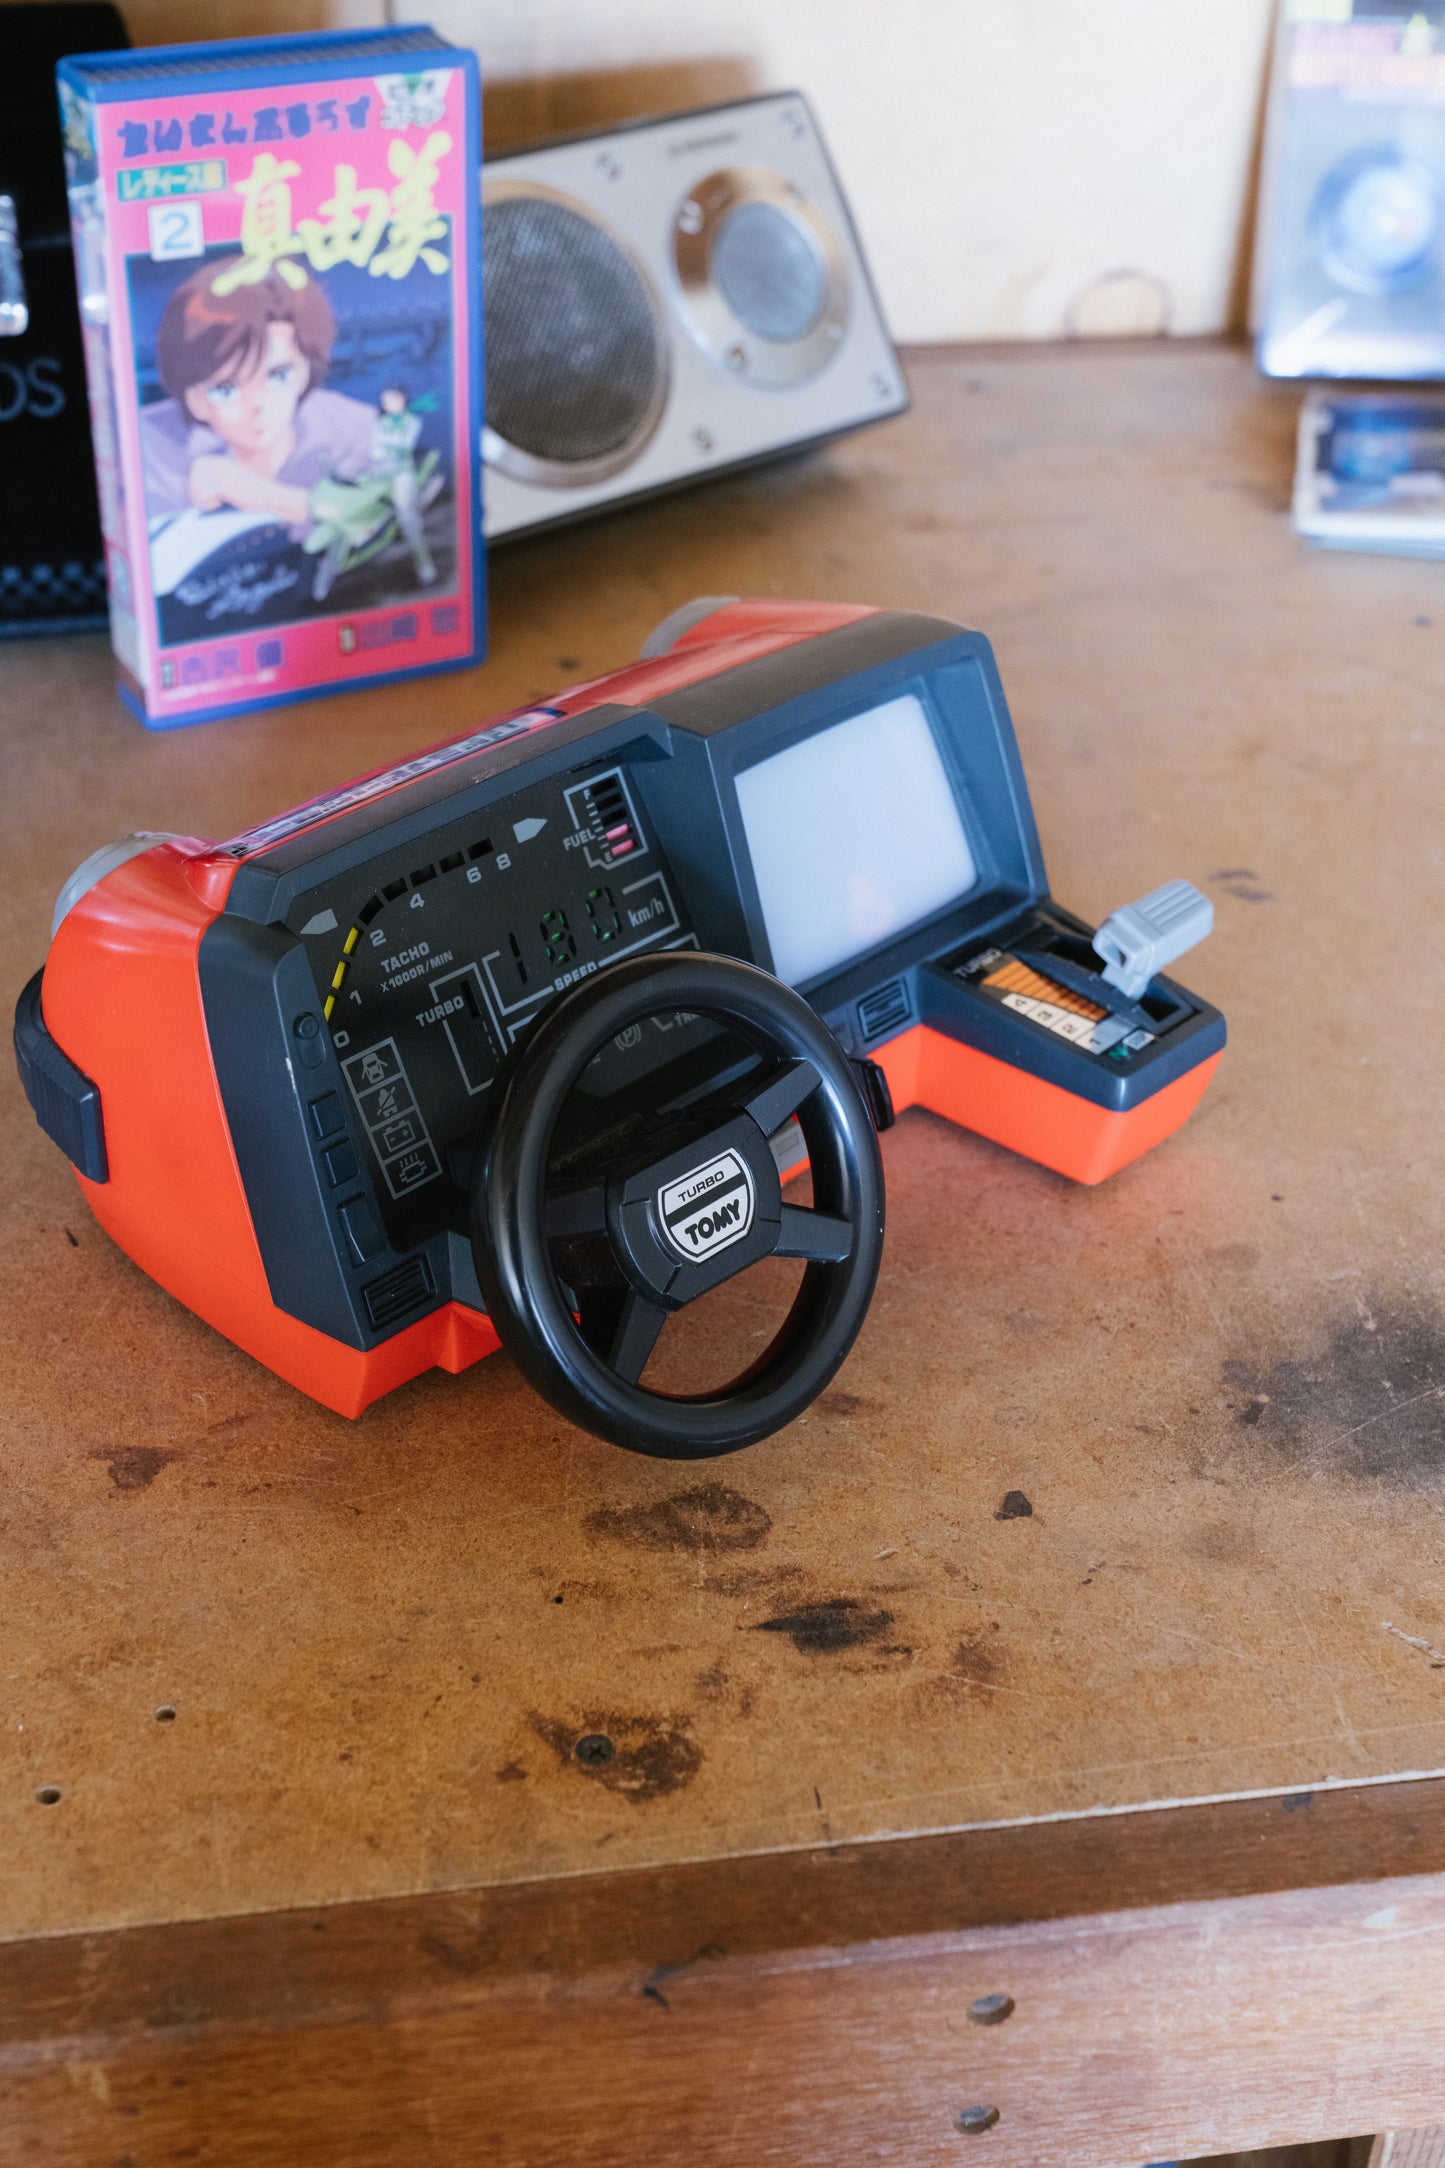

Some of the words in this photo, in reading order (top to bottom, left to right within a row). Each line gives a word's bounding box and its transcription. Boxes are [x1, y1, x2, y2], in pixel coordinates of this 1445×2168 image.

[211, 131, 452, 297] 真由美
[159, 211, 194, 251] 2
[582, 788, 592, 801] F
[563, 828, 597, 851] FUEL
[627, 897, 665, 928] km/h
[333, 1030, 350, 1048] 0
[349, 990, 363, 1006] 1
[370, 929, 387, 947] 2
[409, 893, 425, 909] 4
[466, 866, 482, 884] 6
[496, 853, 511, 870] 8
[380, 942, 430, 973] TACHO
[953, 947, 1002, 978] TURBO
[554, 961, 598, 992] SPEED
[415, 996, 465, 1027] TURBO
[678, 1170, 725, 1202] TURBO
[684, 1198, 741, 1246] TOMY
